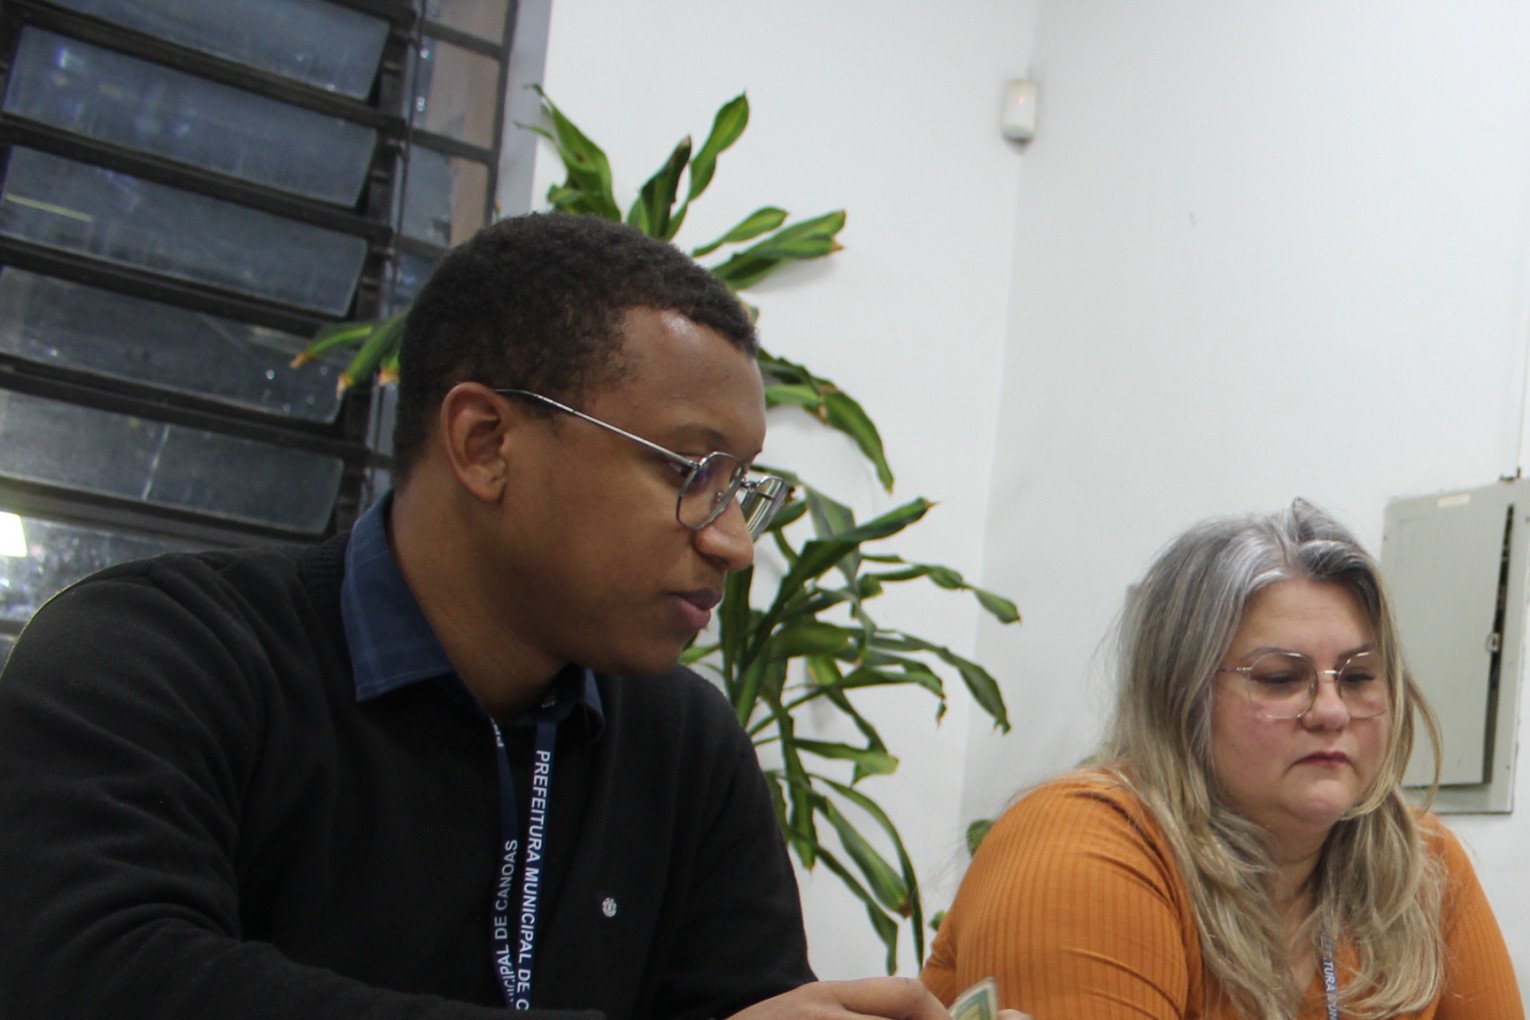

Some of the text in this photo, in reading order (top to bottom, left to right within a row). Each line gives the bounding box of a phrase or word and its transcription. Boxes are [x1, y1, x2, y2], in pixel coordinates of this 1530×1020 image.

[526, 750, 550, 863] PREFEITURA
[495, 839, 518, 911] CANOAS
[494, 915, 508, 940] DE
[519, 867, 539, 964] MUNICIPAL
[516, 969, 531, 993] DE
